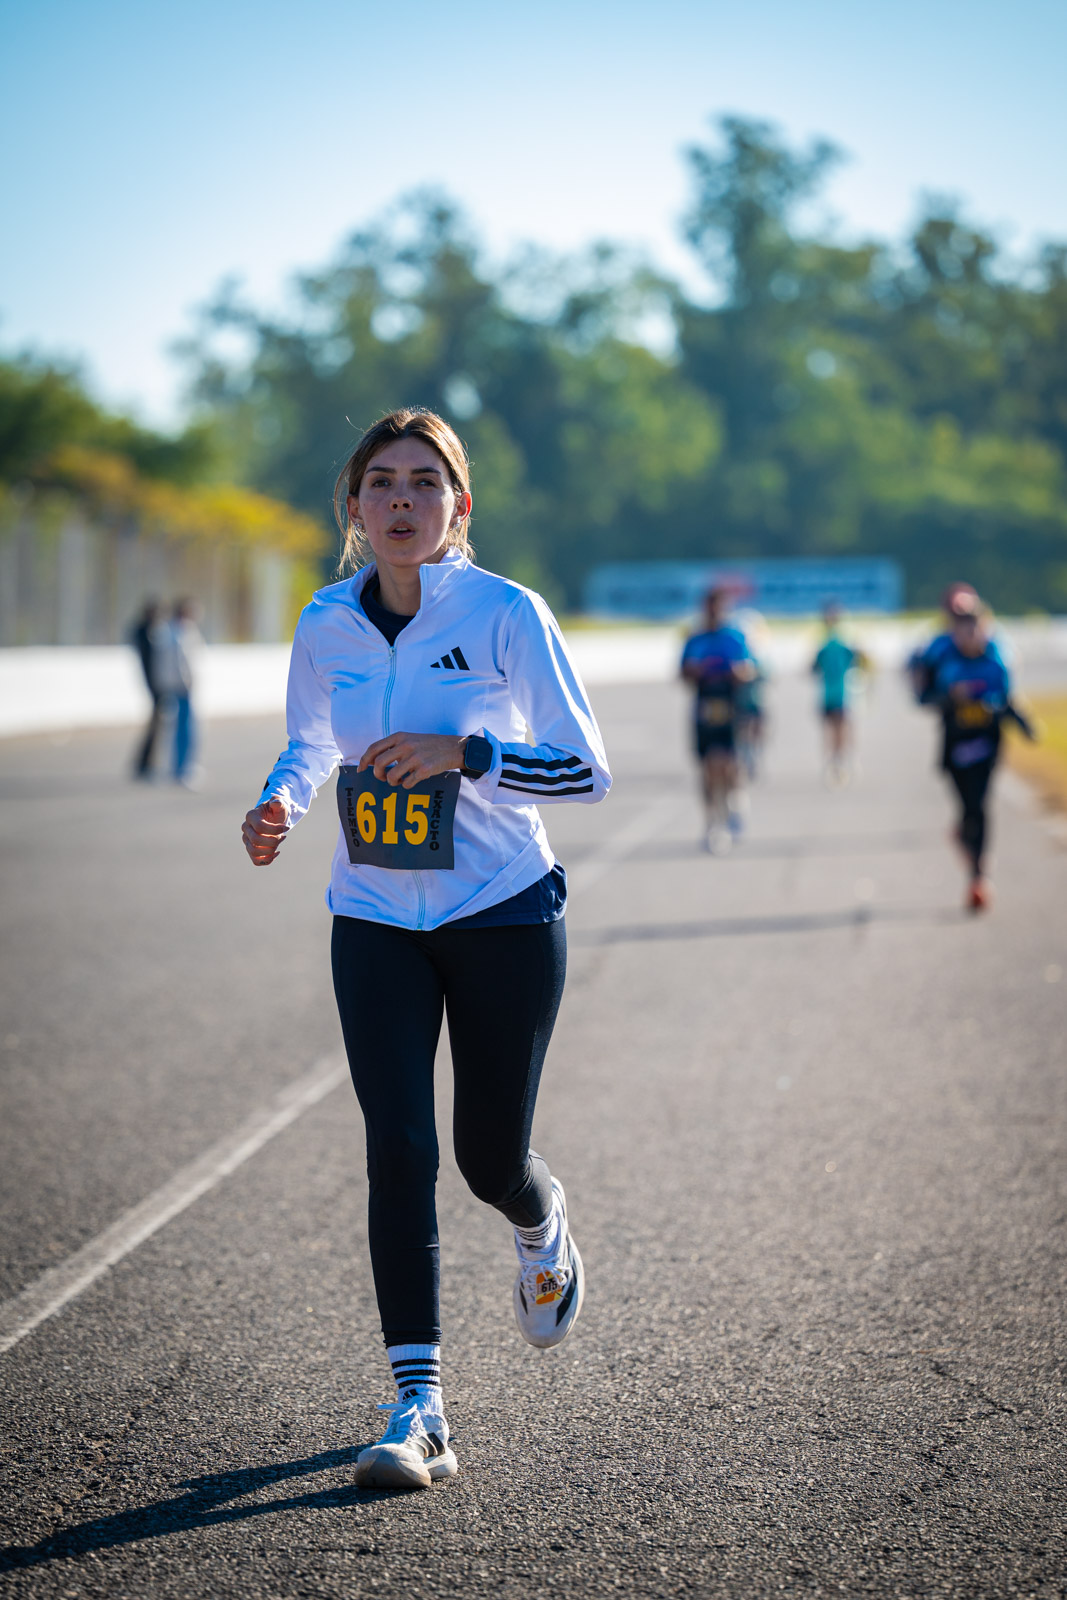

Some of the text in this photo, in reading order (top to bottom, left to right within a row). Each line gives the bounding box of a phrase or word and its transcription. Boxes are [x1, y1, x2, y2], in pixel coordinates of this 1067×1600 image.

[345, 787, 360, 847] TIEMPO
[356, 791, 430, 845] 615
[429, 790, 444, 851] EXACTO
[541, 1280, 558, 1292] 615
